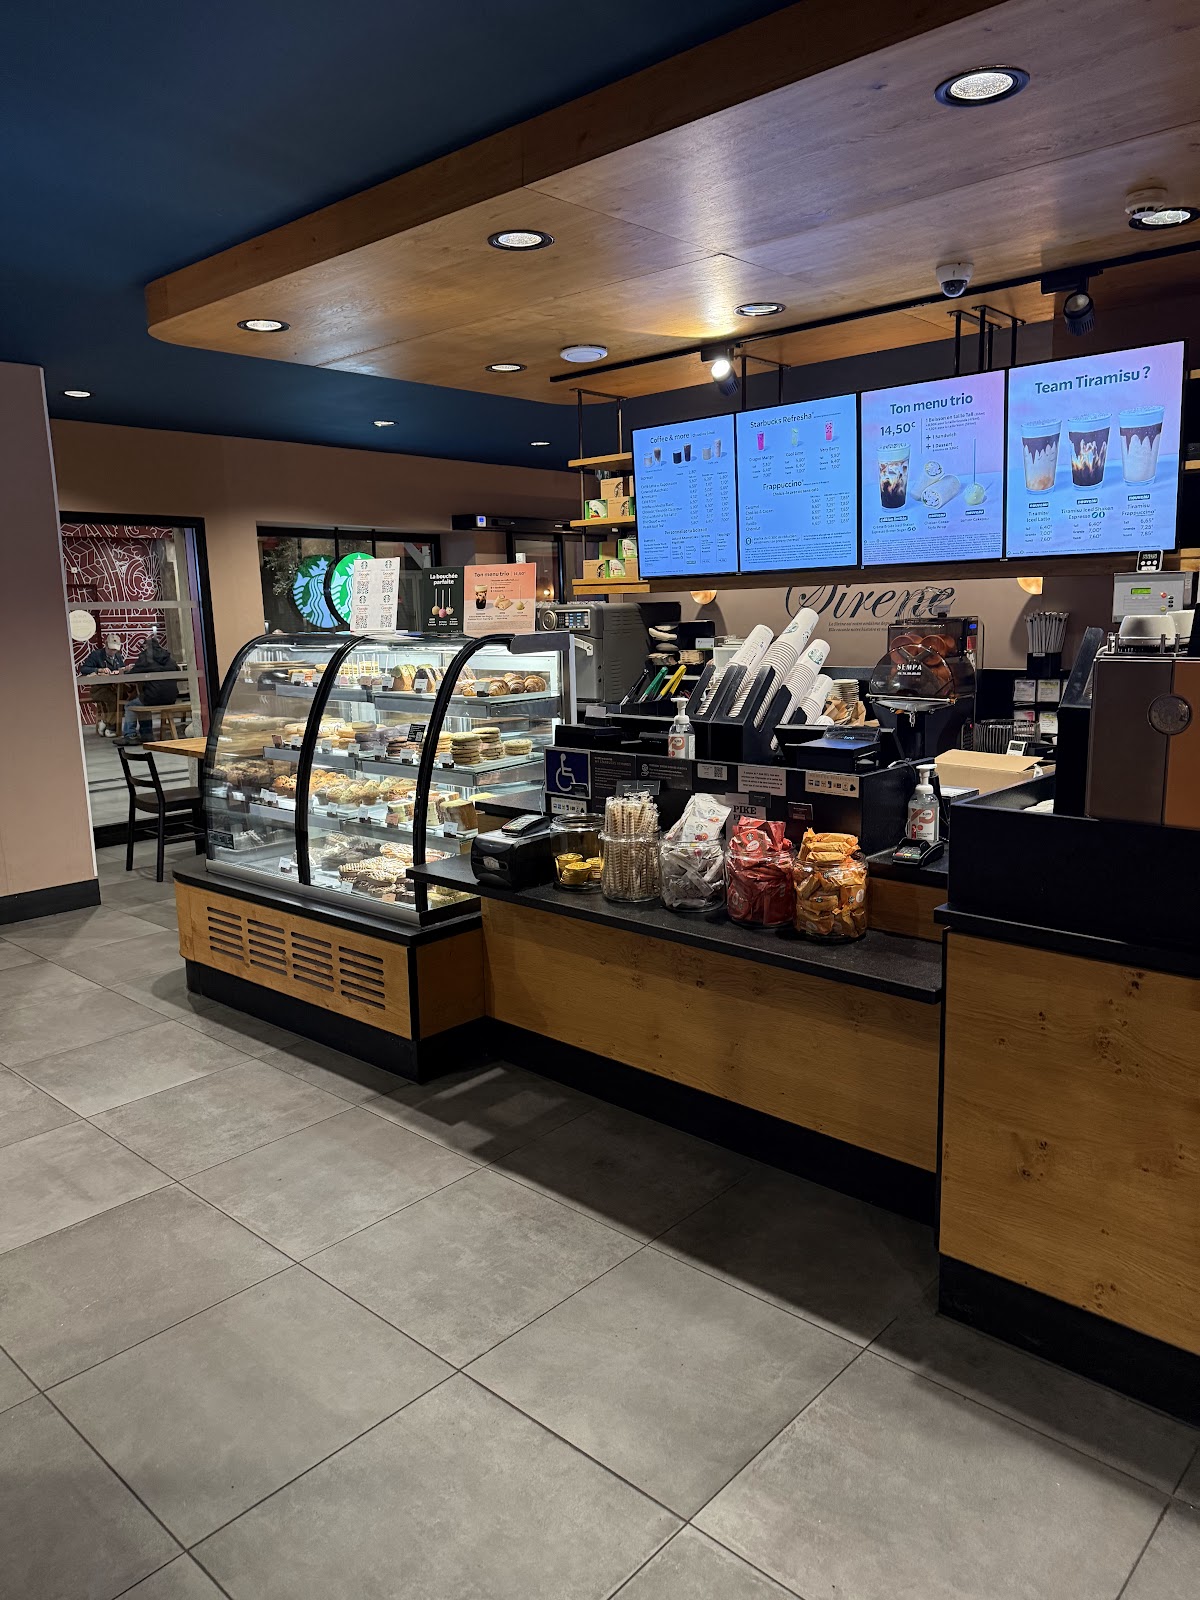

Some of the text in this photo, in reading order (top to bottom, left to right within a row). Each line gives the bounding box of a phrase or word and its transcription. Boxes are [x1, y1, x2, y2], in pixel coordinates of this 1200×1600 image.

[1035, 366, 1150, 394] Team Tiramisu ?
[890, 393, 973, 414] Ton menu trio
[750, 418, 782, 428] Starbucks
[733, 805, 756, 814] PIKE
